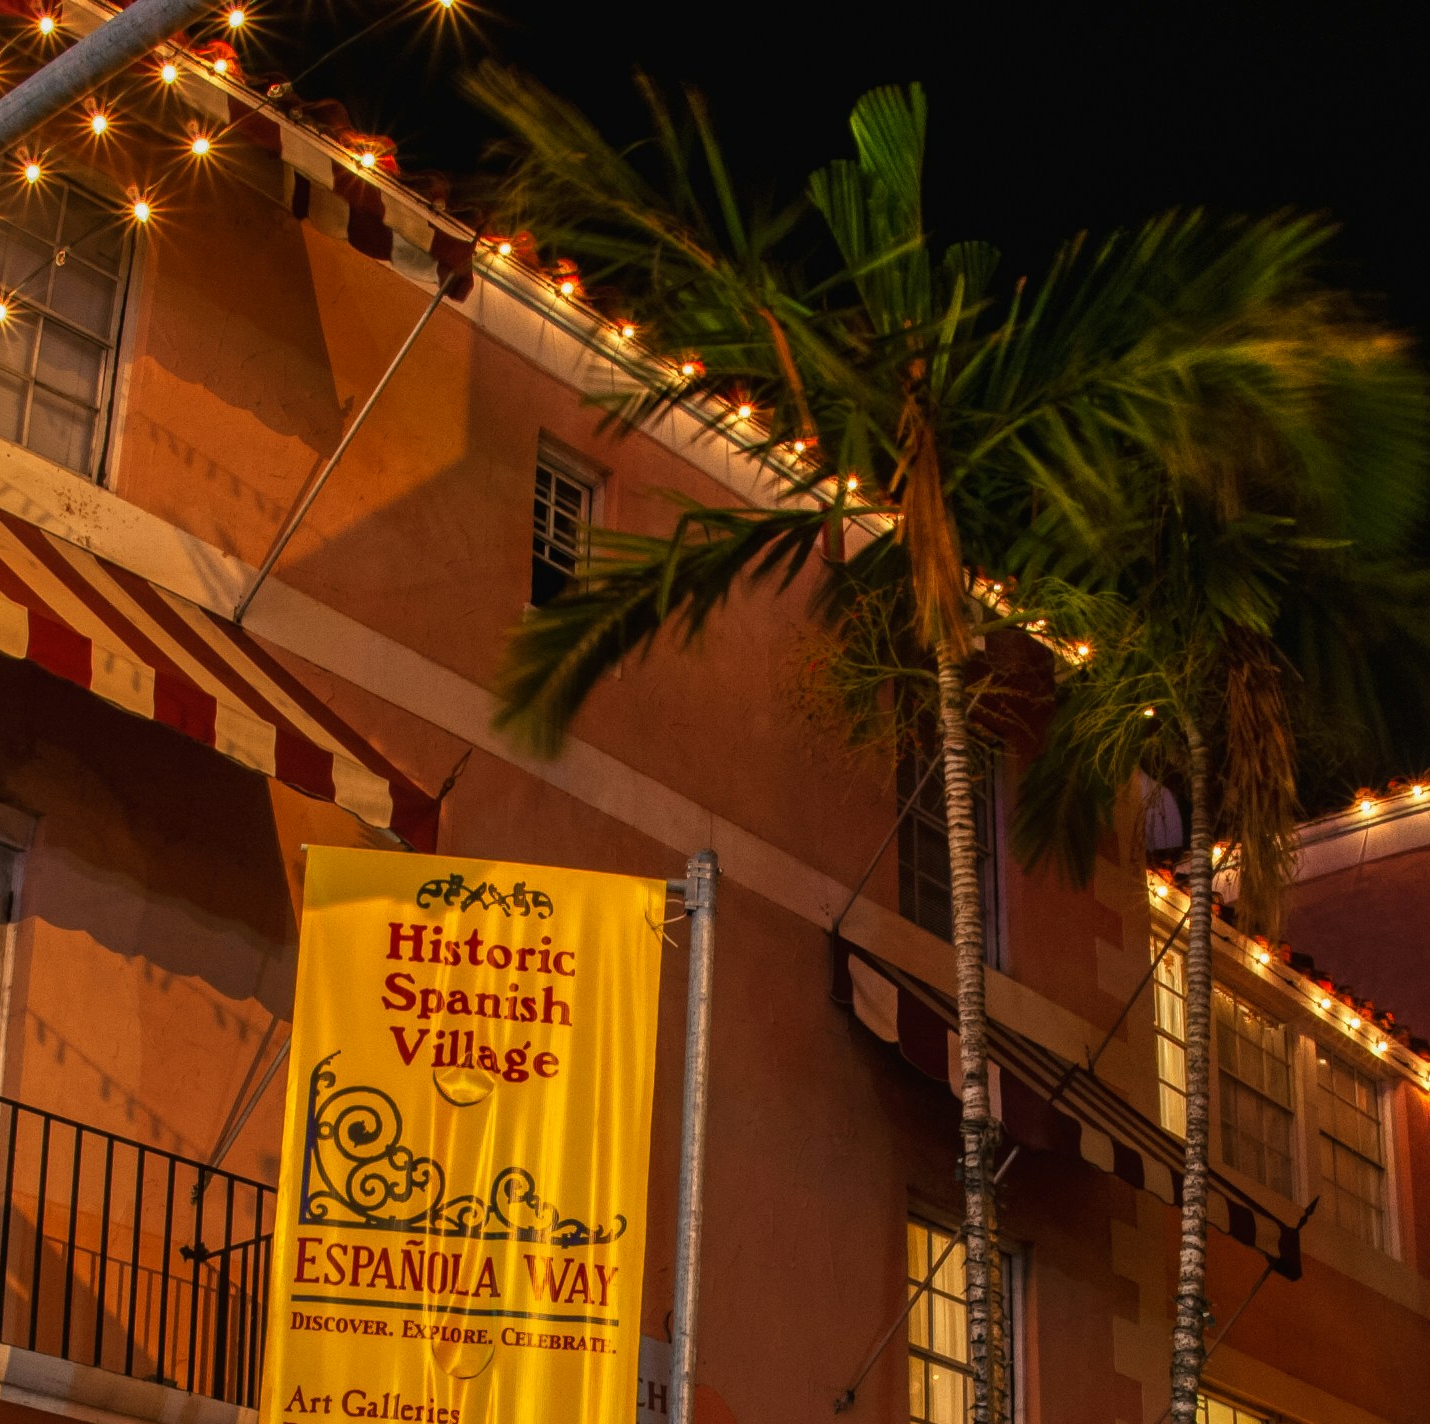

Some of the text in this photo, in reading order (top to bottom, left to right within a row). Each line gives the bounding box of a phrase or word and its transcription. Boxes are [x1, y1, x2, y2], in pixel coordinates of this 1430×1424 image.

[386, 922, 576, 977] Historic
[382, 973, 572, 1026] Spanish
[390, 1026, 560, 1083] Village
[293, 1237, 619, 1307] ESPAÑOLA WAY
[290, 1311, 618, 1355] DISCOVER. EXPLORE. CELEBRATE.
[284, 1385, 333, 1417] Art
